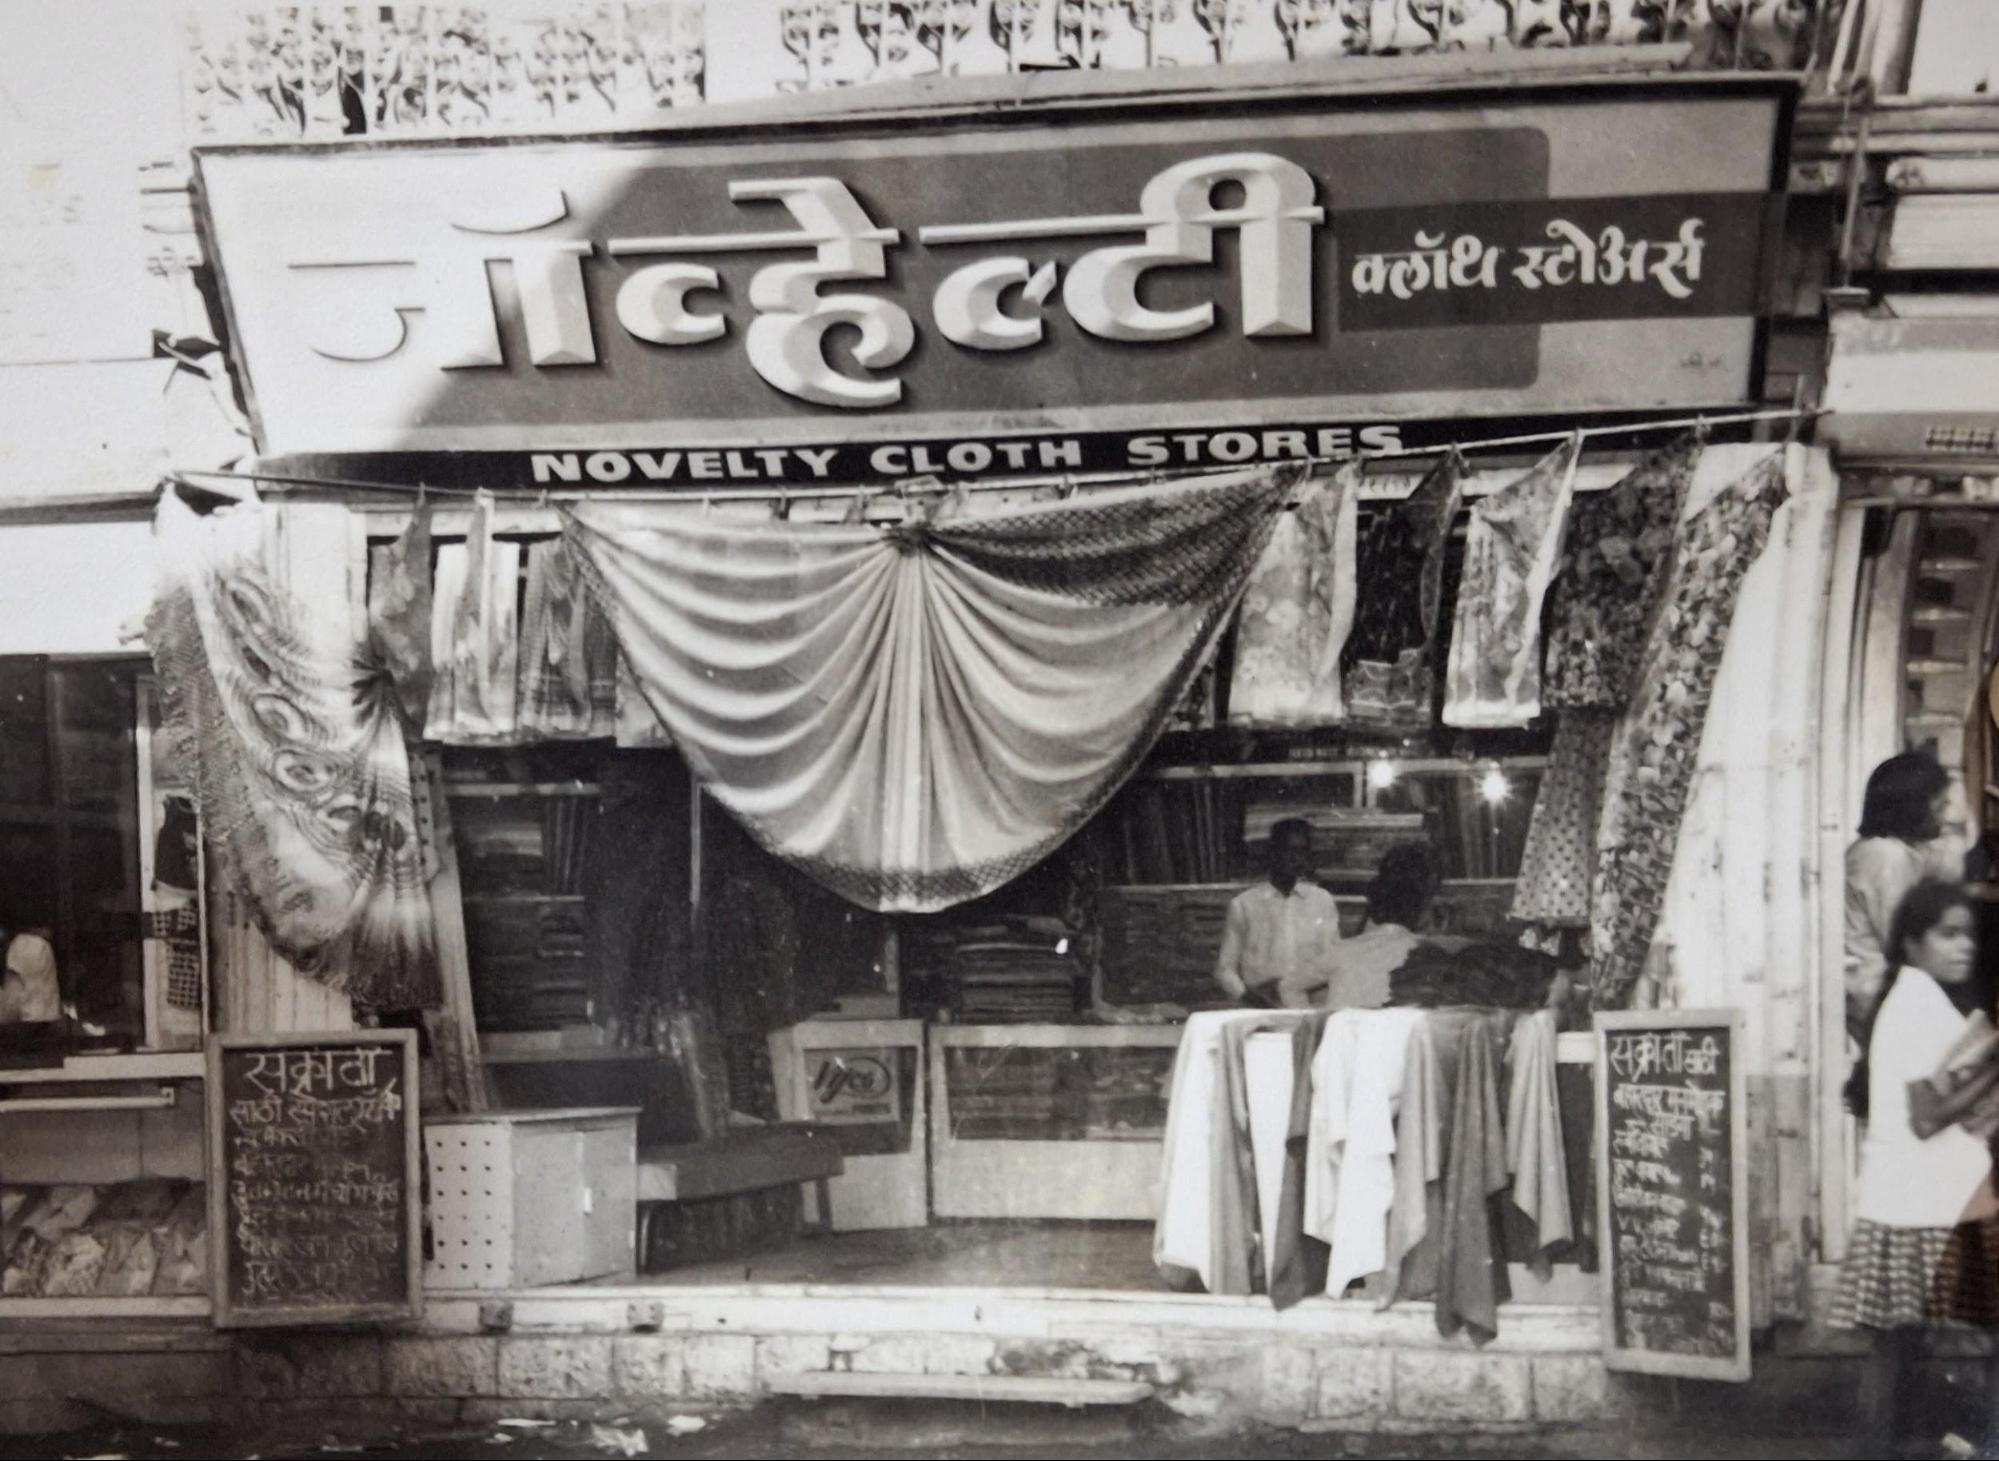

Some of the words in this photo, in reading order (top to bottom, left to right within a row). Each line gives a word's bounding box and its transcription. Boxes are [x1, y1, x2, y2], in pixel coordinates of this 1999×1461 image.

[1351, 229, 1504, 299] क्लॉथ
[1511, 217, 1706, 299] स्टोअर्स
[530, 448, 839, 484] NOVELTY
[869, 440, 1083, 473] CLOTH
[1126, 425, 1404, 466] STORES
